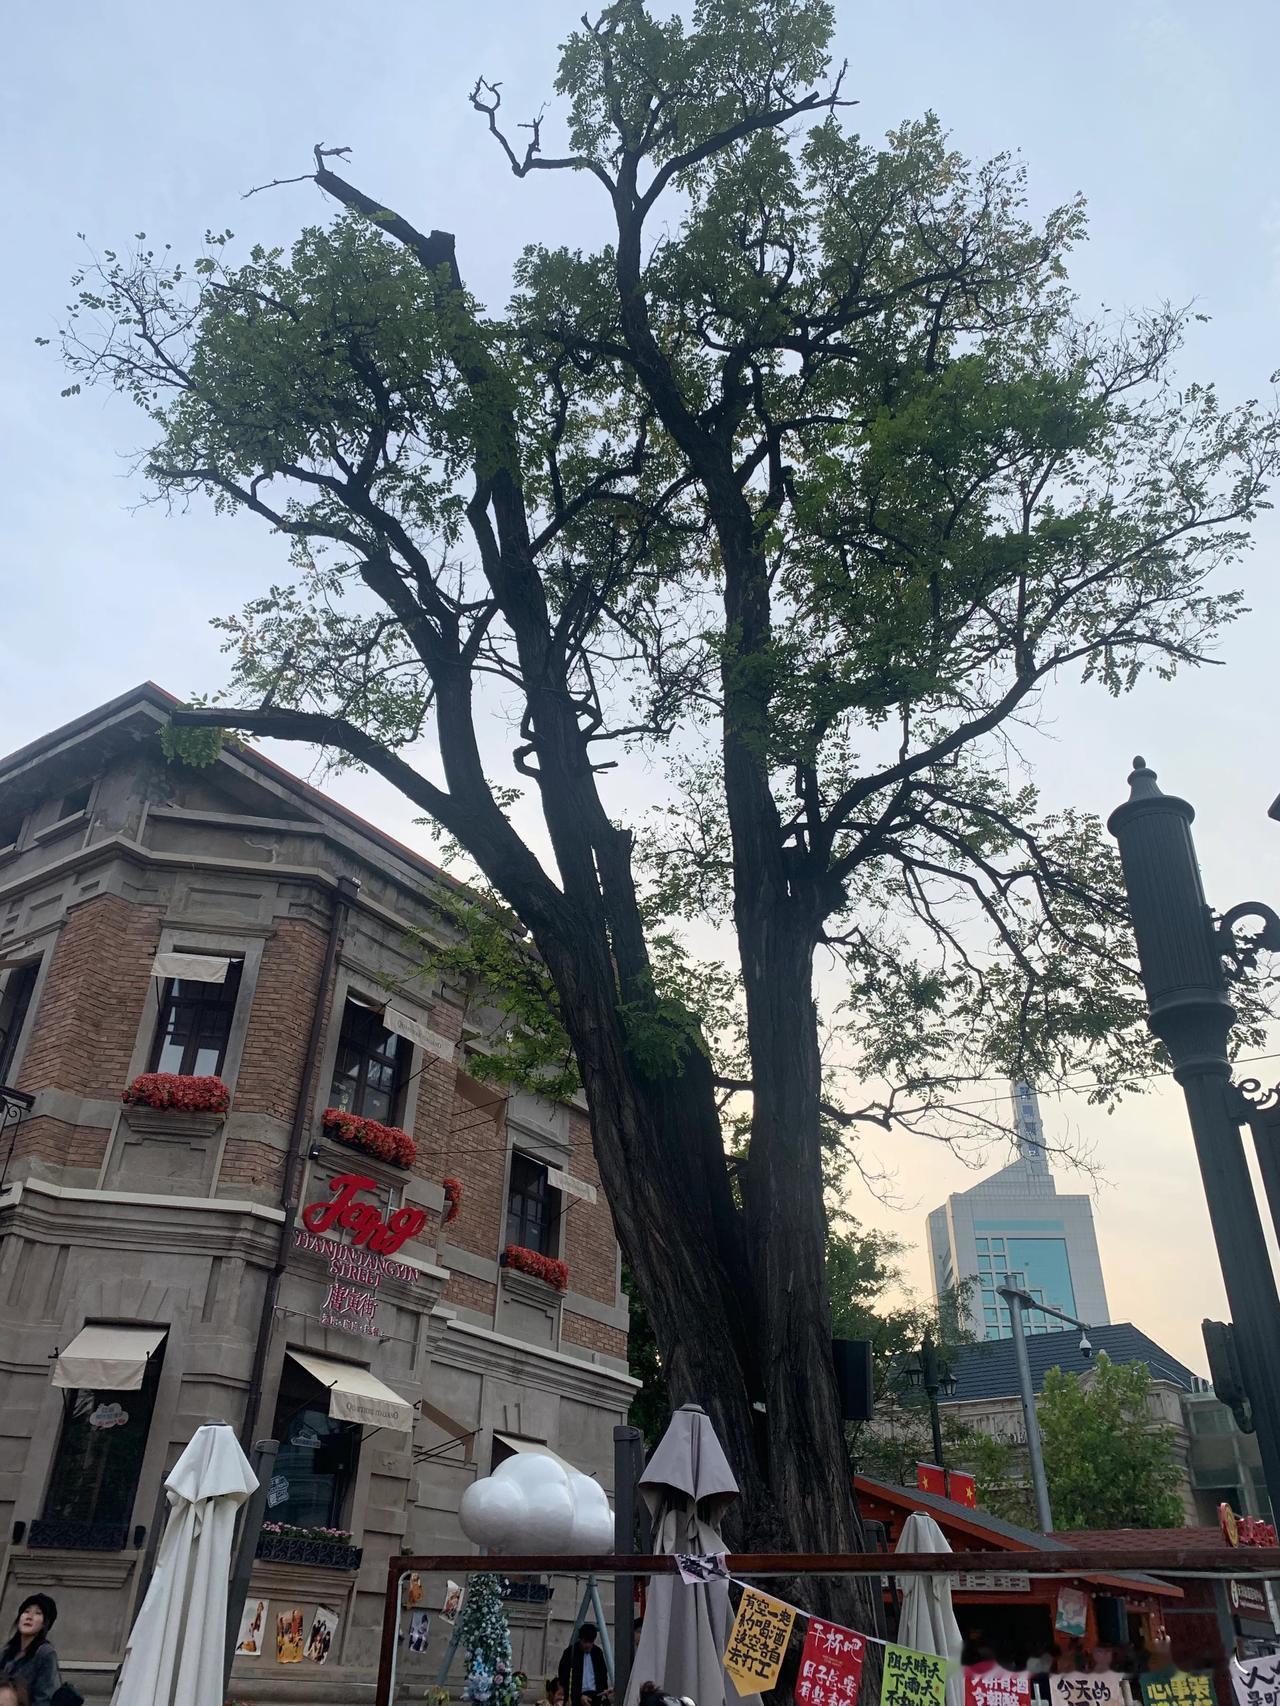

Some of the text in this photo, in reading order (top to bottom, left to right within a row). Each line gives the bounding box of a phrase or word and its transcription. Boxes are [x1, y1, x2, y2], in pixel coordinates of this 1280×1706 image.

[302, 1174, 427, 1256] Tang
[329, 1259, 383, 1287] STREET
[743, 1593, 792, 1627] 有空一起
[809, 1623, 862, 1663] 干杯吧
[728, 1644, 772, 1679] 去打工
[1240, 1664, 1280, 1689] 人
[803, 1660, 857, 1697] 日子总要
[890, 1672, 938, 1700] 下雨天
[1057, 1679, 1111, 1701] 今天的
[1147, 1673, 1210, 1700] 心事装
